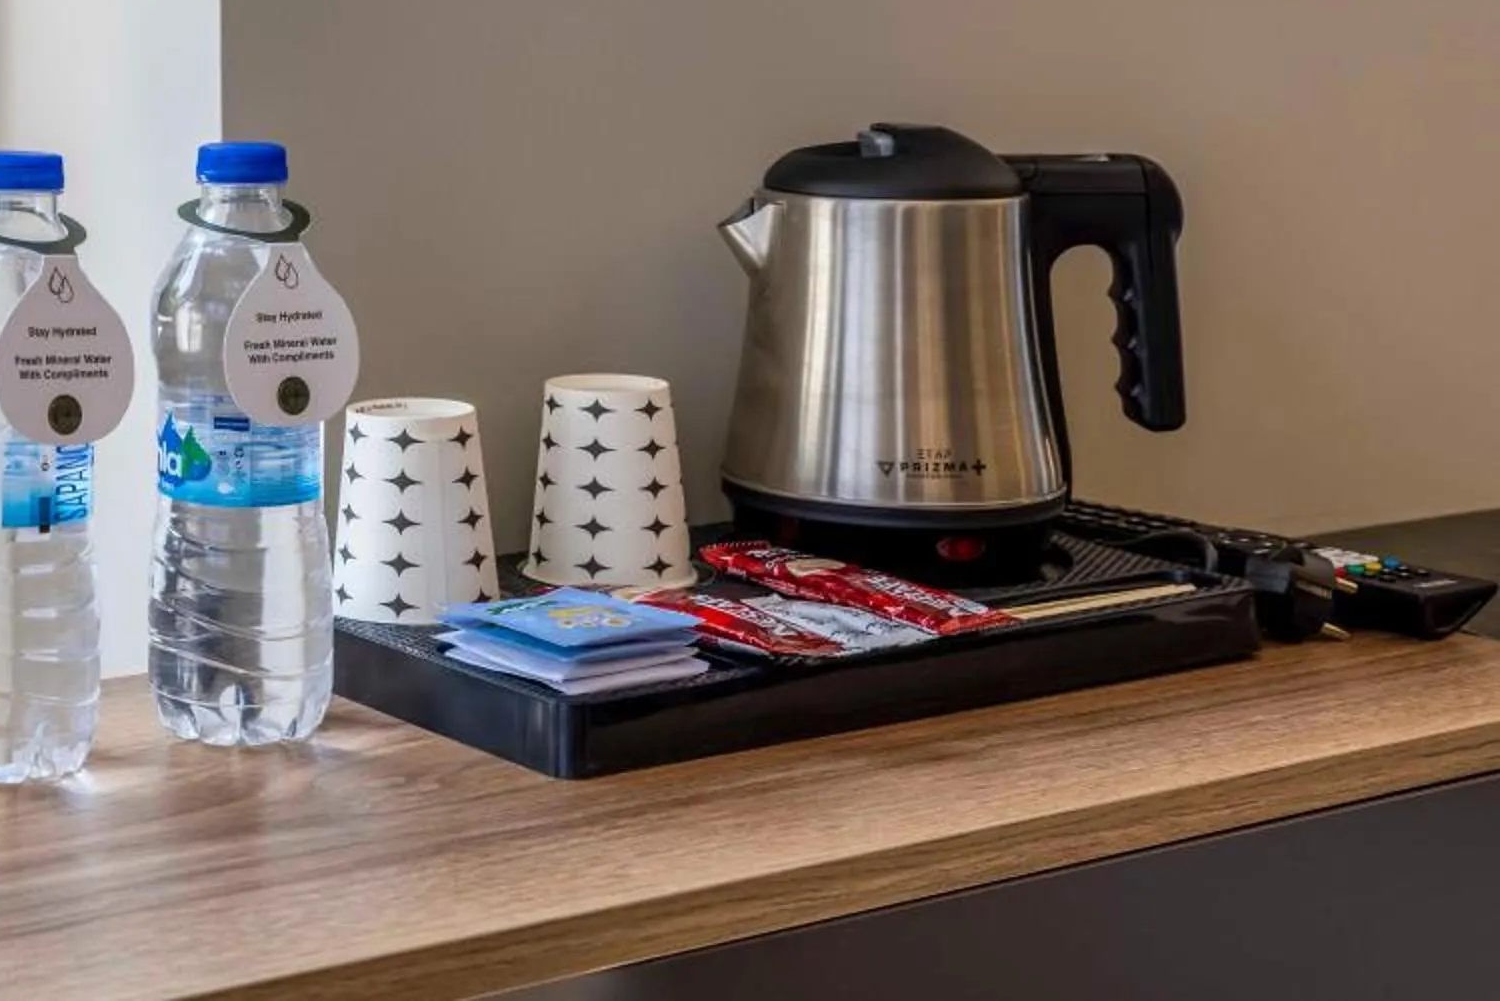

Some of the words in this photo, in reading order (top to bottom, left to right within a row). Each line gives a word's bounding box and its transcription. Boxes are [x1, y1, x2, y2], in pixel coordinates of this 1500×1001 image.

[256, 311, 277, 324] Stay
[279, 310, 323, 323] Hydrated
[27, 326, 50, 339] Stay
[52, 326, 97, 339] Hydrated
[273, 338, 309, 349] Mineral
[45, 355, 81, 366] Mineral
[247, 353, 270, 364] With
[271, 350, 336, 363] Compliments
[19, 369, 42, 380] With
[43, 368, 109, 381] Compliments
[55, 443, 89, 522] SAPANC
